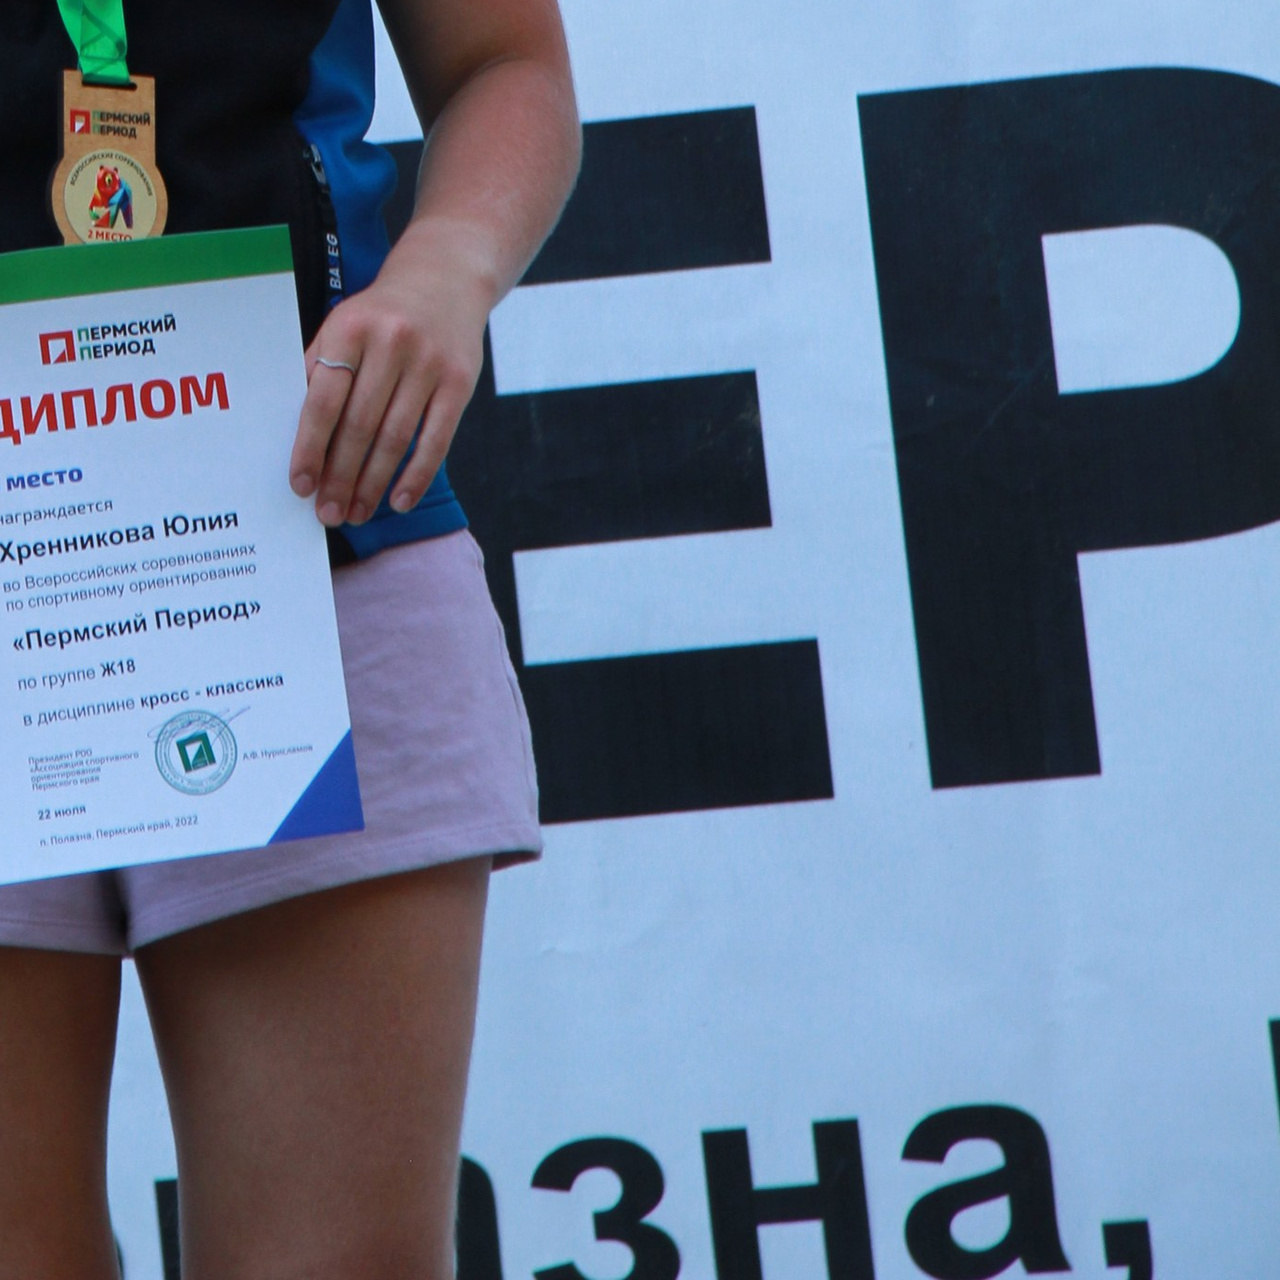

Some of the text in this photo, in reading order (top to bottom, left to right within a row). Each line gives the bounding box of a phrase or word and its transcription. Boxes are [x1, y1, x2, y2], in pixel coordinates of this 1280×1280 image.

[92, 110, 150, 126] ПЕРМСКИЙ
[92, 124, 137, 139] ПЕРИОД
[70, 152, 152, 196] ВСЕРОССИЙСКИЕ СОРЕВНОВАНИЯ
[88, 230, 133, 241] 2 МЕСТО
[78, 313, 176, 341] ПЕРМСКИЙ
[79, 338, 155, 360] ПЕРИОД
[7, 467, 83, 491] место
[163, 512, 238, 537] Юлия
[3, 544, 256, 592] во Всероссийских соревнованиях
[6, 563, 257, 612] по спортивному ориентированию
[13, 600, 261, 651] «Пермский Период»
[18, 659, 136, 690] по группе Ж18
[23, 715, 32, 726] в
[38, 699, 135, 726] дисциплине
[141, 690, 190, 710] кросс
[206, 674, 284, 697] классика
[28, 748, 93, 766] Президент РОО
[85, 752, 140, 766] спортивного
[31, 766, 101, 783] ориентирования
[32, 780, 78, 791] Пермского
[38, 805, 87, 820] 22 июля
[96, 823, 146, 840] Пермский
[175, 815, 199, 827] 2022
